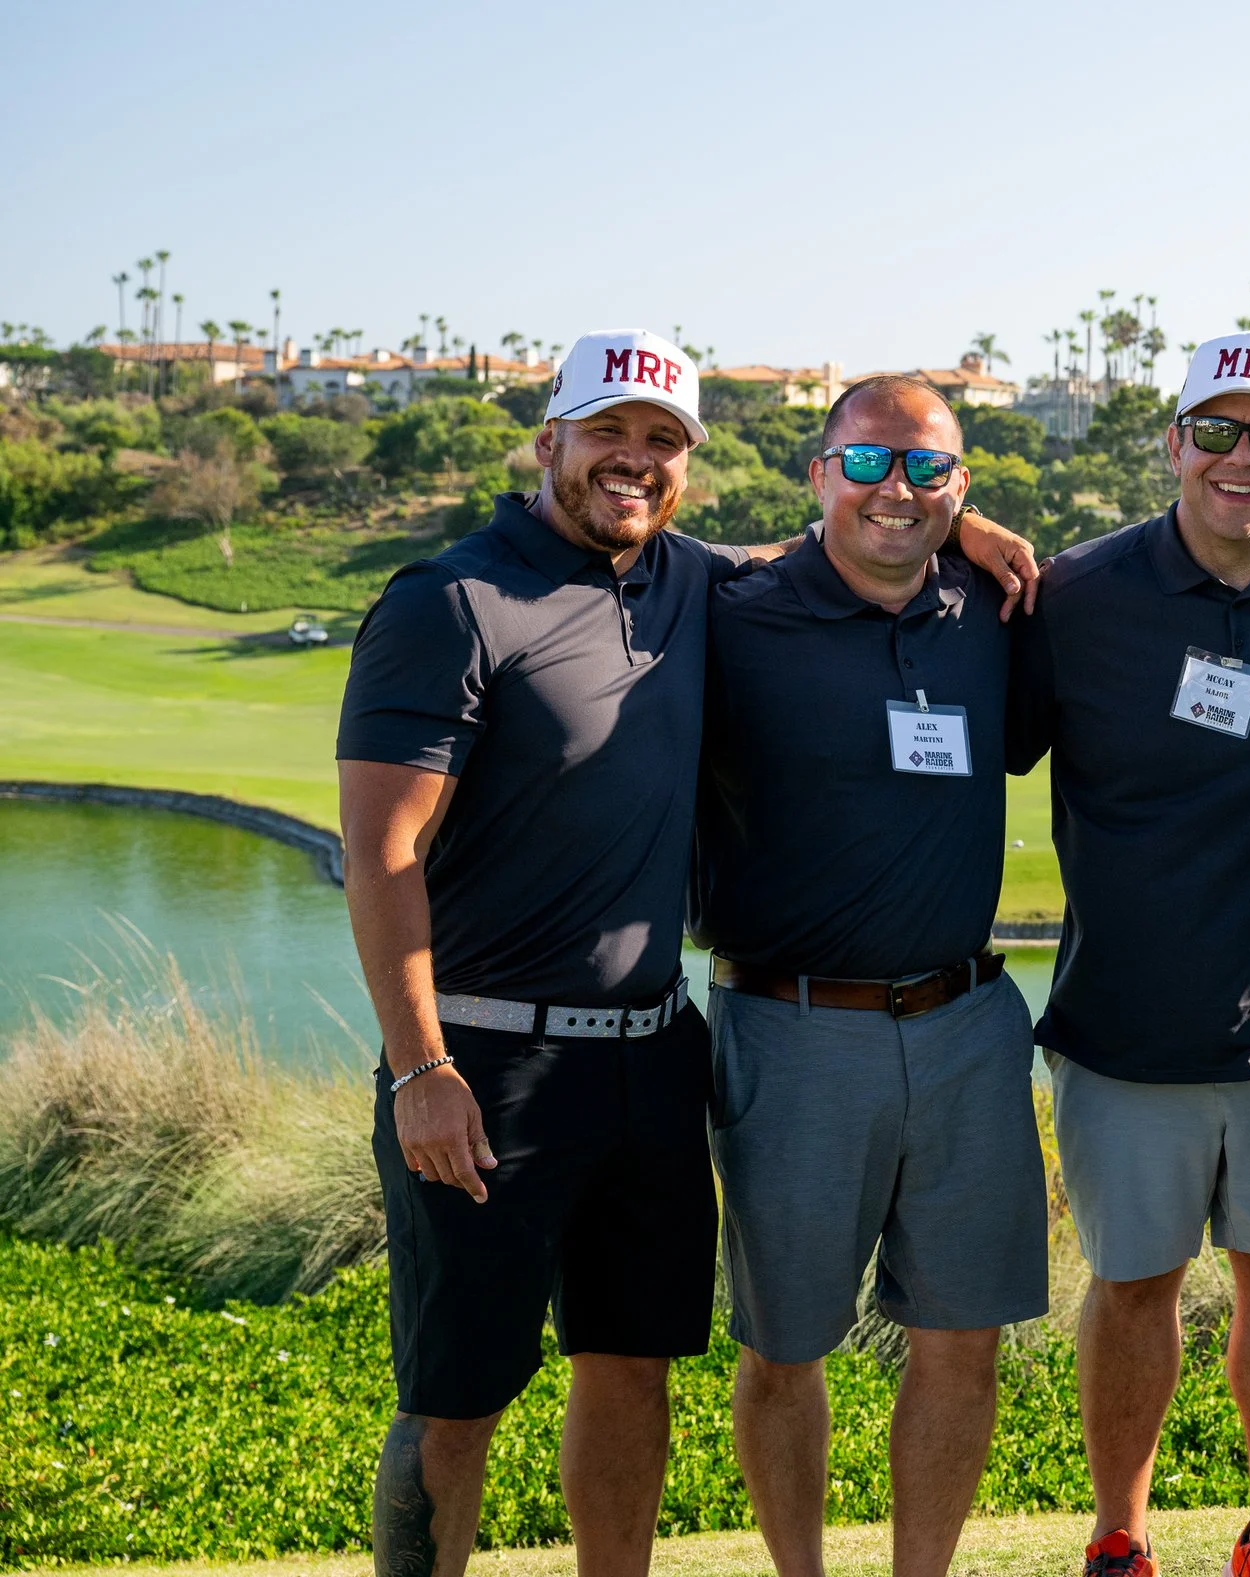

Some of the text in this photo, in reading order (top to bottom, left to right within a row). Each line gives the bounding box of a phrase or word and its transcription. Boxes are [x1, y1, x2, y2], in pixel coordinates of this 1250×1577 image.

[603, 349, 681, 394] MRF
[1205, 673, 1235, 688] MCCAY
[1205, 688, 1229, 699] MAJOR
[1207, 705, 1236, 718] MARINE
[1206, 712, 1234, 726] RAIDER
[916, 723, 938, 731] ALEX
[913, 735, 943, 743] MARTINI
[924, 751, 953, 760] MARINE
[925, 759, 954, 767] RAIDER
